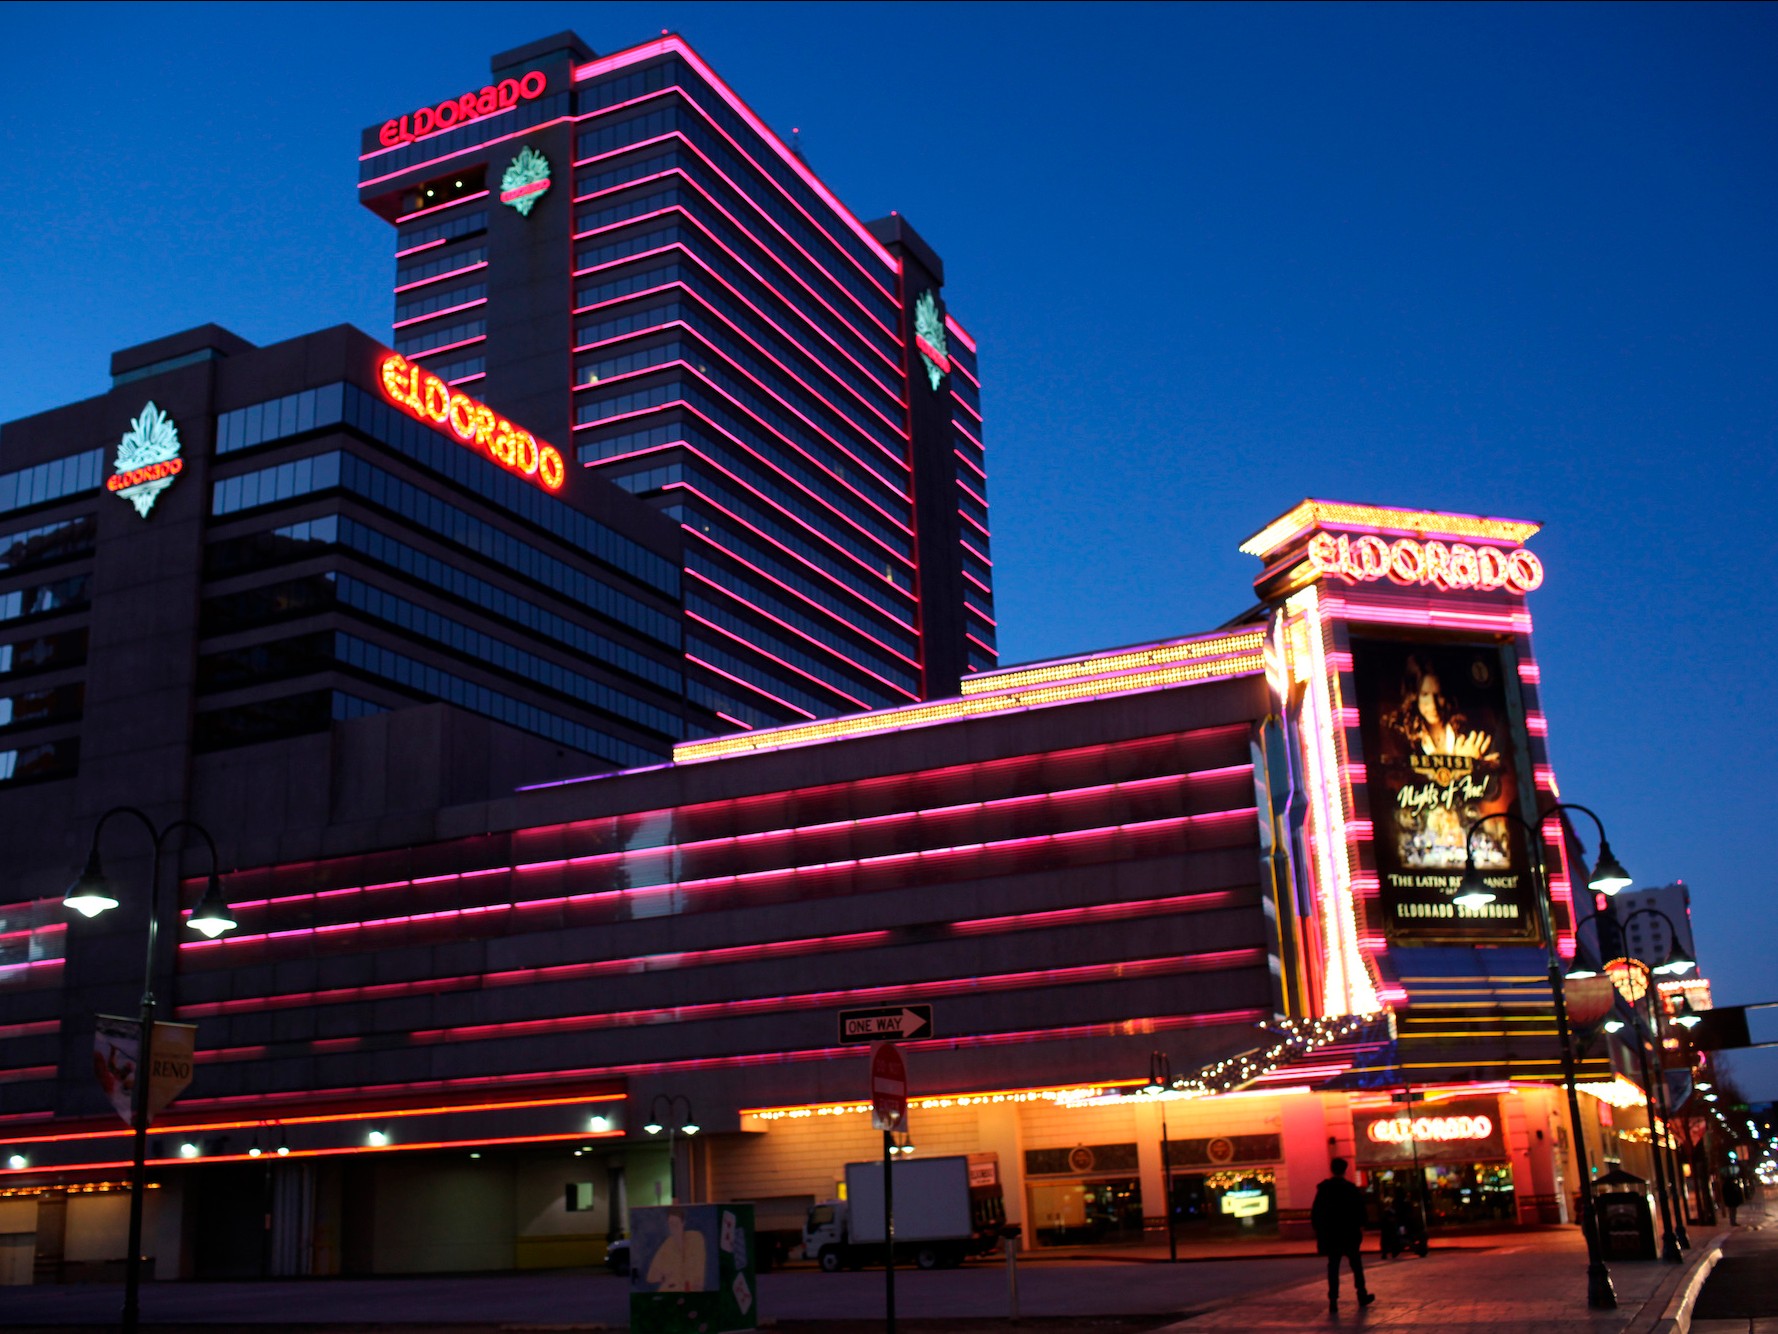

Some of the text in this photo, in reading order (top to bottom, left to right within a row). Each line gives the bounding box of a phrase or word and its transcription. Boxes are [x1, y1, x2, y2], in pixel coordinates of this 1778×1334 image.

[1415, 875, 1447, 888] LATIN
[1397, 903, 1454, 918] ELDORADO
[848, 1017, 903, 1034] ONE WAY
[153, 1061, 189, 1078] RENO
